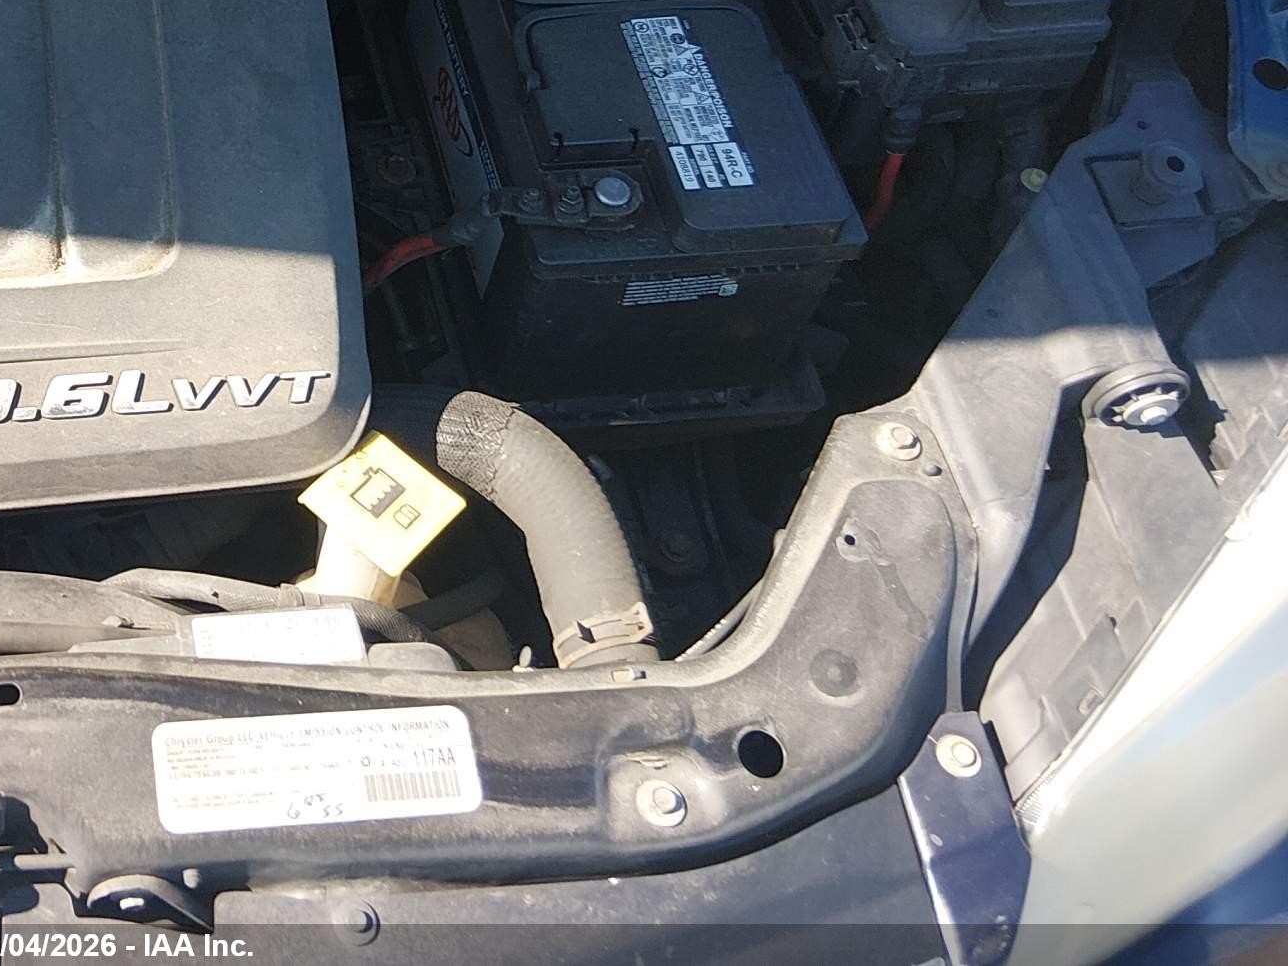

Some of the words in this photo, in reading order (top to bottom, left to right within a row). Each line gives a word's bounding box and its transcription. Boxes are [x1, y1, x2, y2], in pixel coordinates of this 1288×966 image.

[721, 148, 743, 179] 94R-C
[206, 735, 234, 746] Group
[390, 720, 450, 732] NFORMATION
